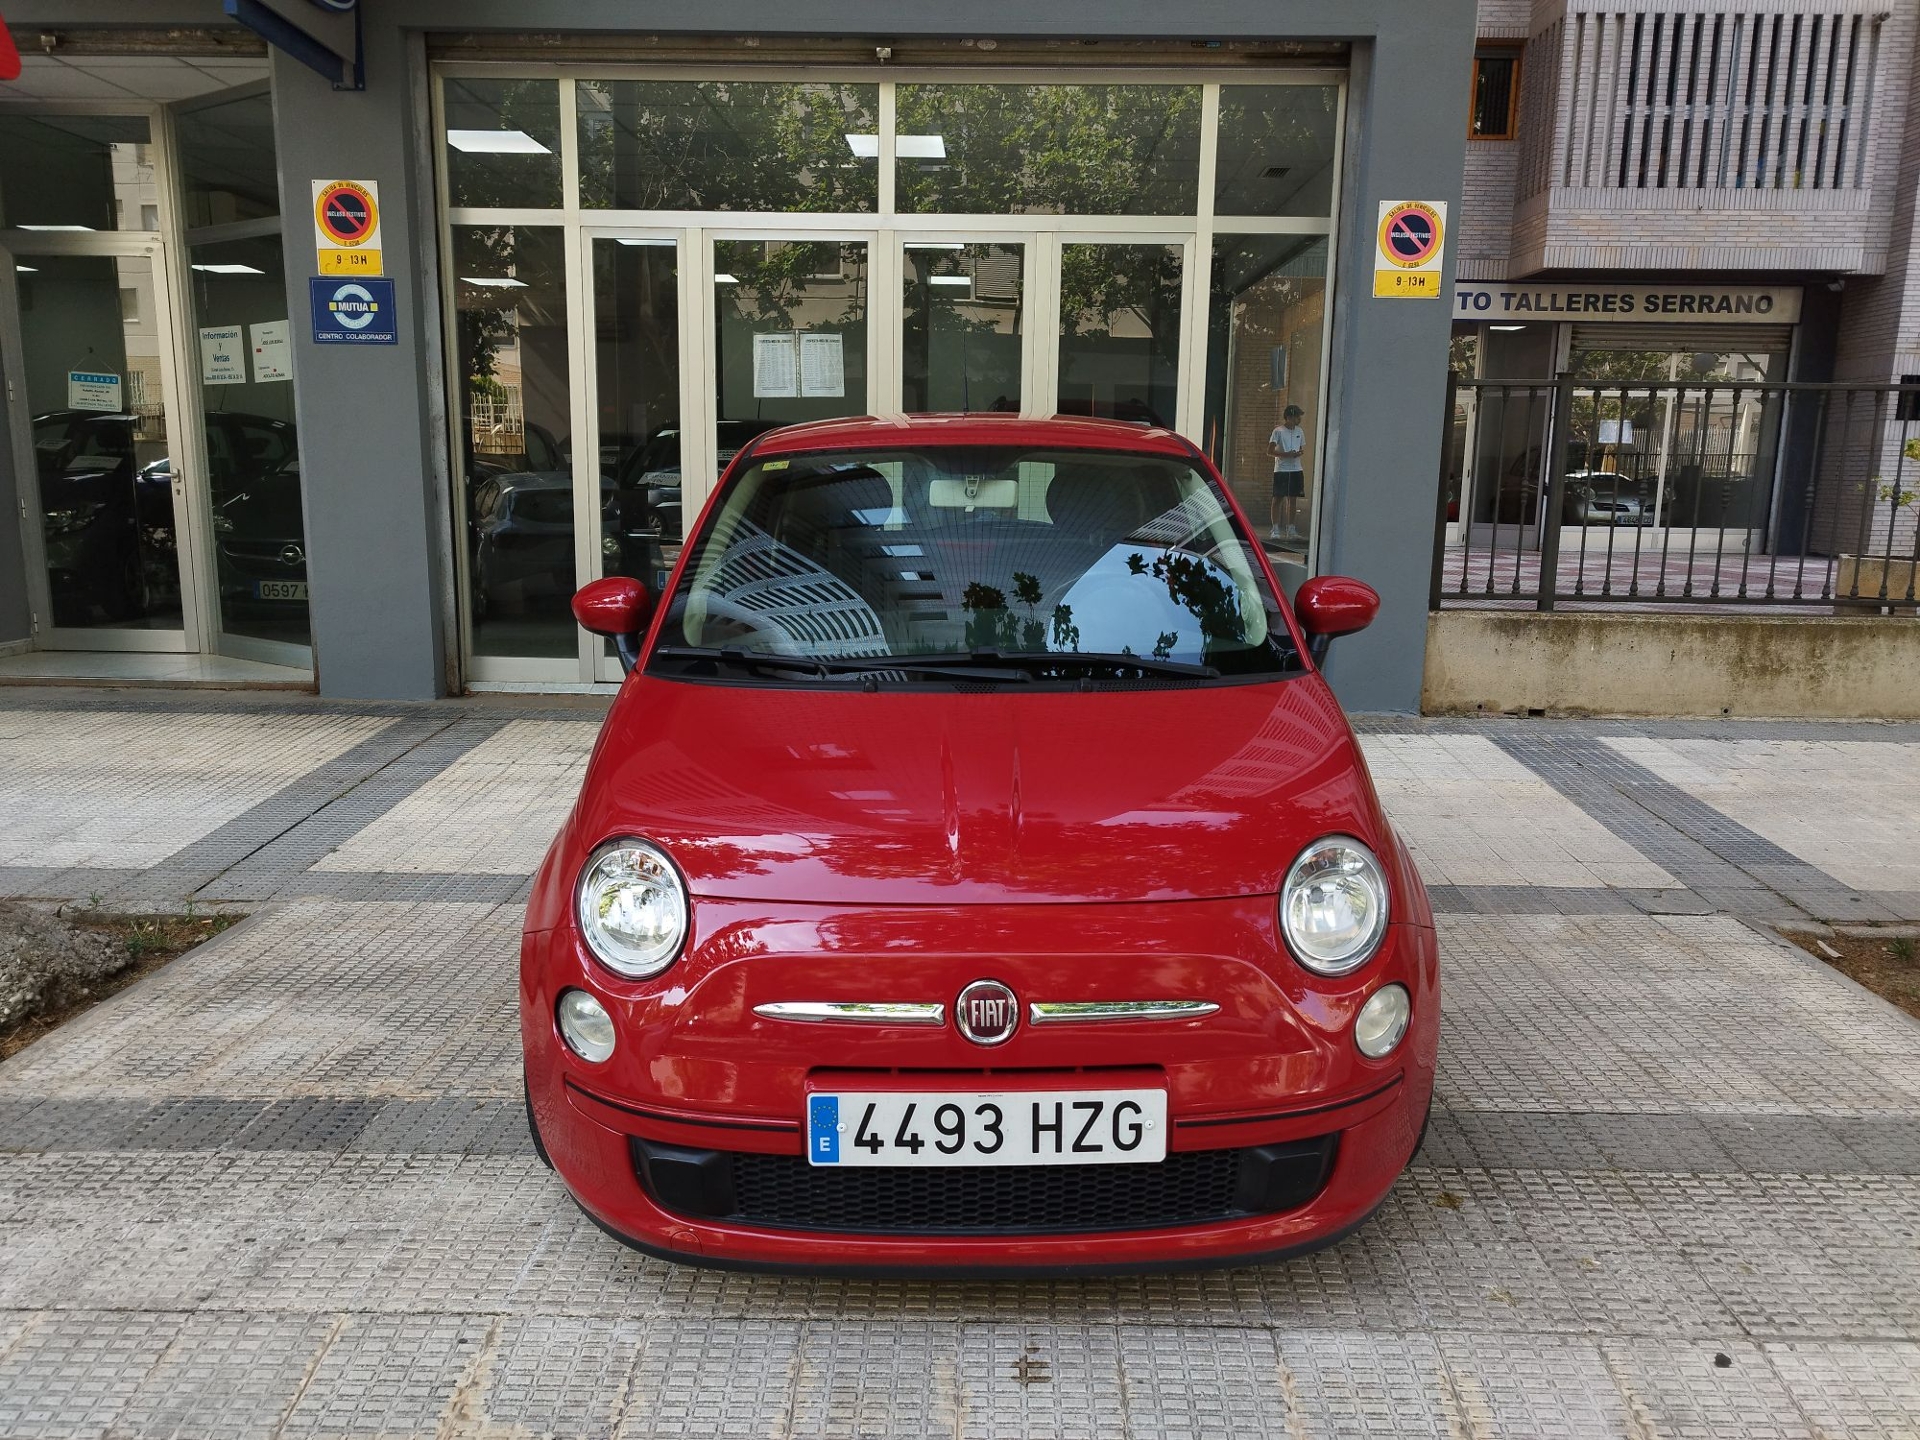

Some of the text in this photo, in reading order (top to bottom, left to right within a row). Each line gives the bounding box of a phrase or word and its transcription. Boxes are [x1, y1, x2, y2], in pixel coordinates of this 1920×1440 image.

[338, 302, 369, 312] MUTUA
[1457, 291, 1774, 315] TO TALLERES SERRANO
[202, 331, 238, 340] Información
[346, 333, 393, 342] COLABORADOR
[212, 354, 230, 363] Ventas
[74, 375, 116, 383] CERRADO
[262, 583, 299, 598] 0597
[971, 1000, 1006, 1027] FIAT
[819, 1100, 1143, 1155] E 4493 HZG
